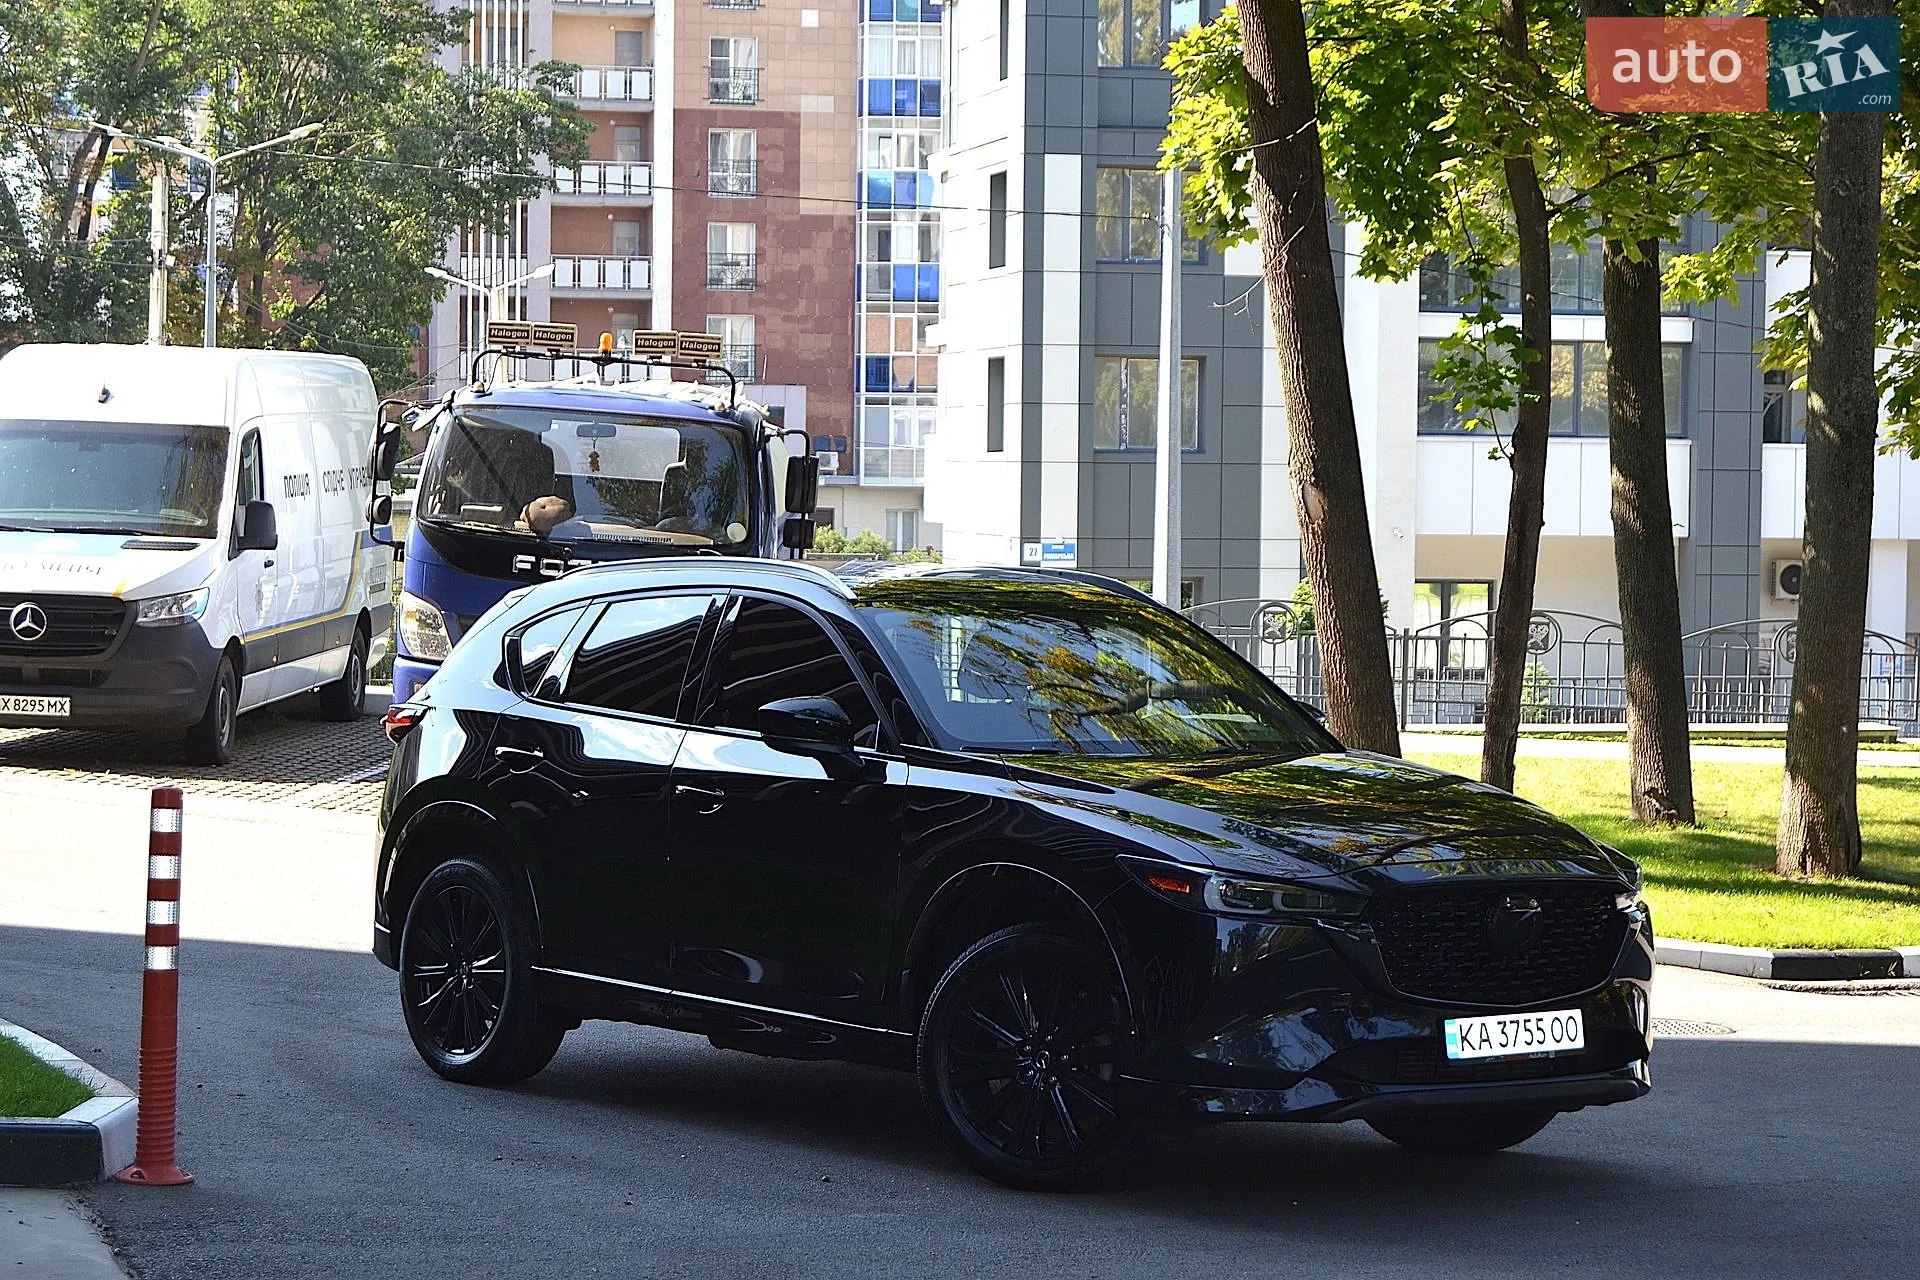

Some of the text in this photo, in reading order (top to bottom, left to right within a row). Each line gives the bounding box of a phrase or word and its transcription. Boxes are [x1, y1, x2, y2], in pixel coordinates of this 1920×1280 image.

[490, 328, 528, 338] Halogen
[535, 330, 572, 341] Halogen
[637, 338, 674, 348] Halogen
[681, 341, 719, 351] Halogen
[347, 466, 372, 490] УПРАВ
[1029, 547, 1038, 557] 27
[13, 698, 45, 712] 8295
[47, 699, 67, 713] MX
[1459, 1022, 1493, 1052] KA
[1497, 1018, 1546, 1048] 3755
